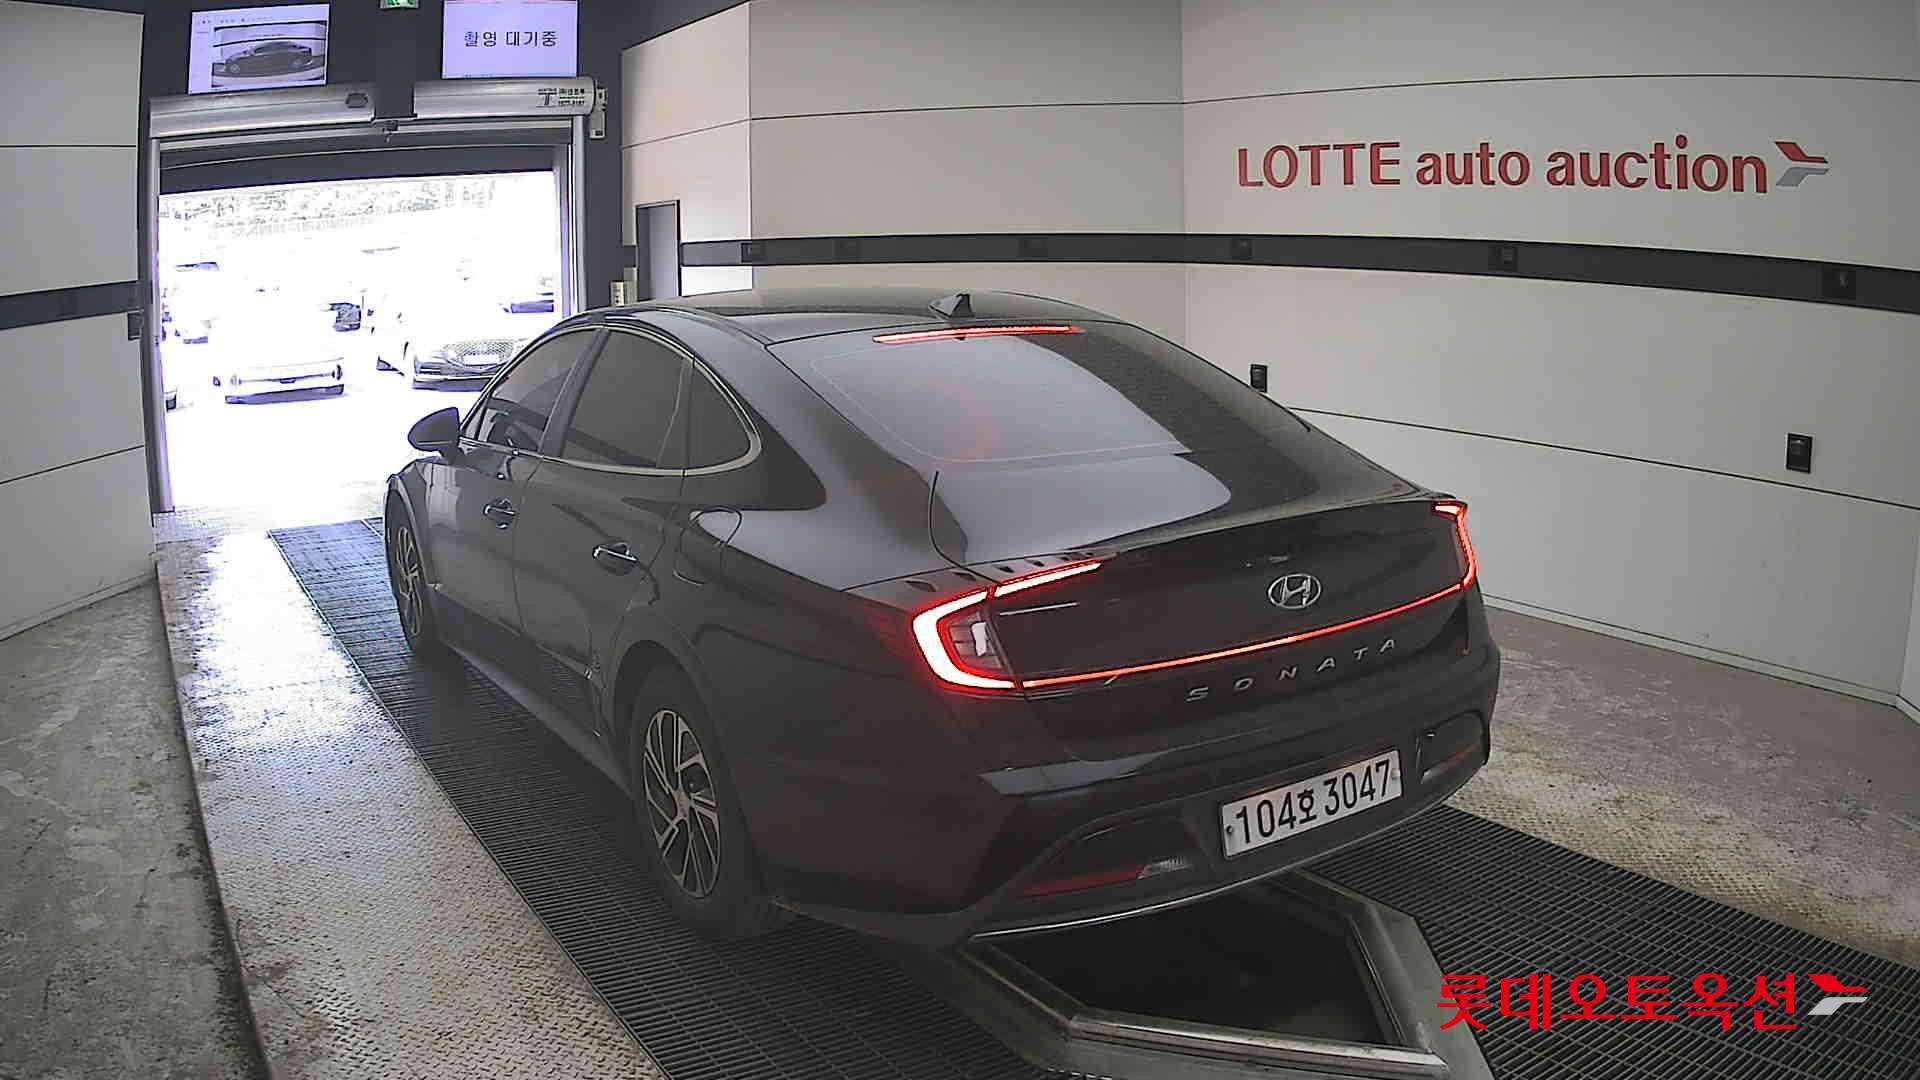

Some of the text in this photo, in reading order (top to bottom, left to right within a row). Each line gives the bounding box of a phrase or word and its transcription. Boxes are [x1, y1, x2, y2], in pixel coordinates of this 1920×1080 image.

[463, 30, 558, 48] 촬영 대기중
[1238, 135, 1767, 194] LOTTE auto auction
[1185, 638, 1396, 703] SONATA
[1323, 758, 1390, 817] 3047
